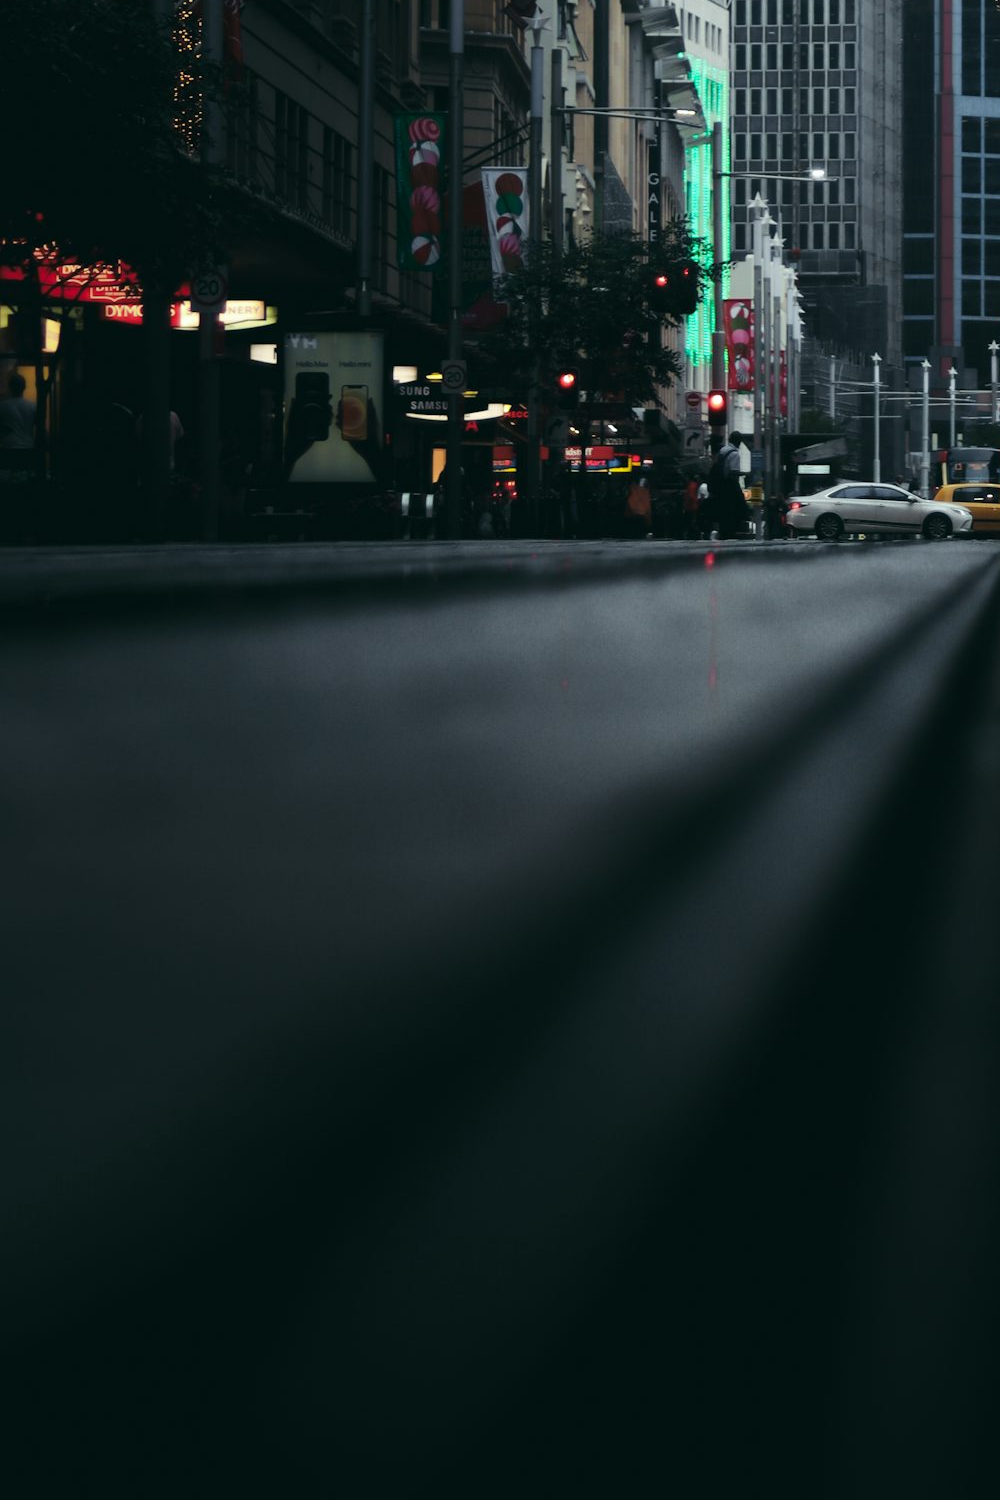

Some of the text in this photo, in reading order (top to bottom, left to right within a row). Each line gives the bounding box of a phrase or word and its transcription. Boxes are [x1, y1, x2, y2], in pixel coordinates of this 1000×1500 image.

[647, 173, 660, 242] GALE
[198, 280, 219, 296] 20
[104, 303, 176, 318] DYMOS
[446, 371, 461, 383] 20
[410, 400, 448, 410] SAMSU
